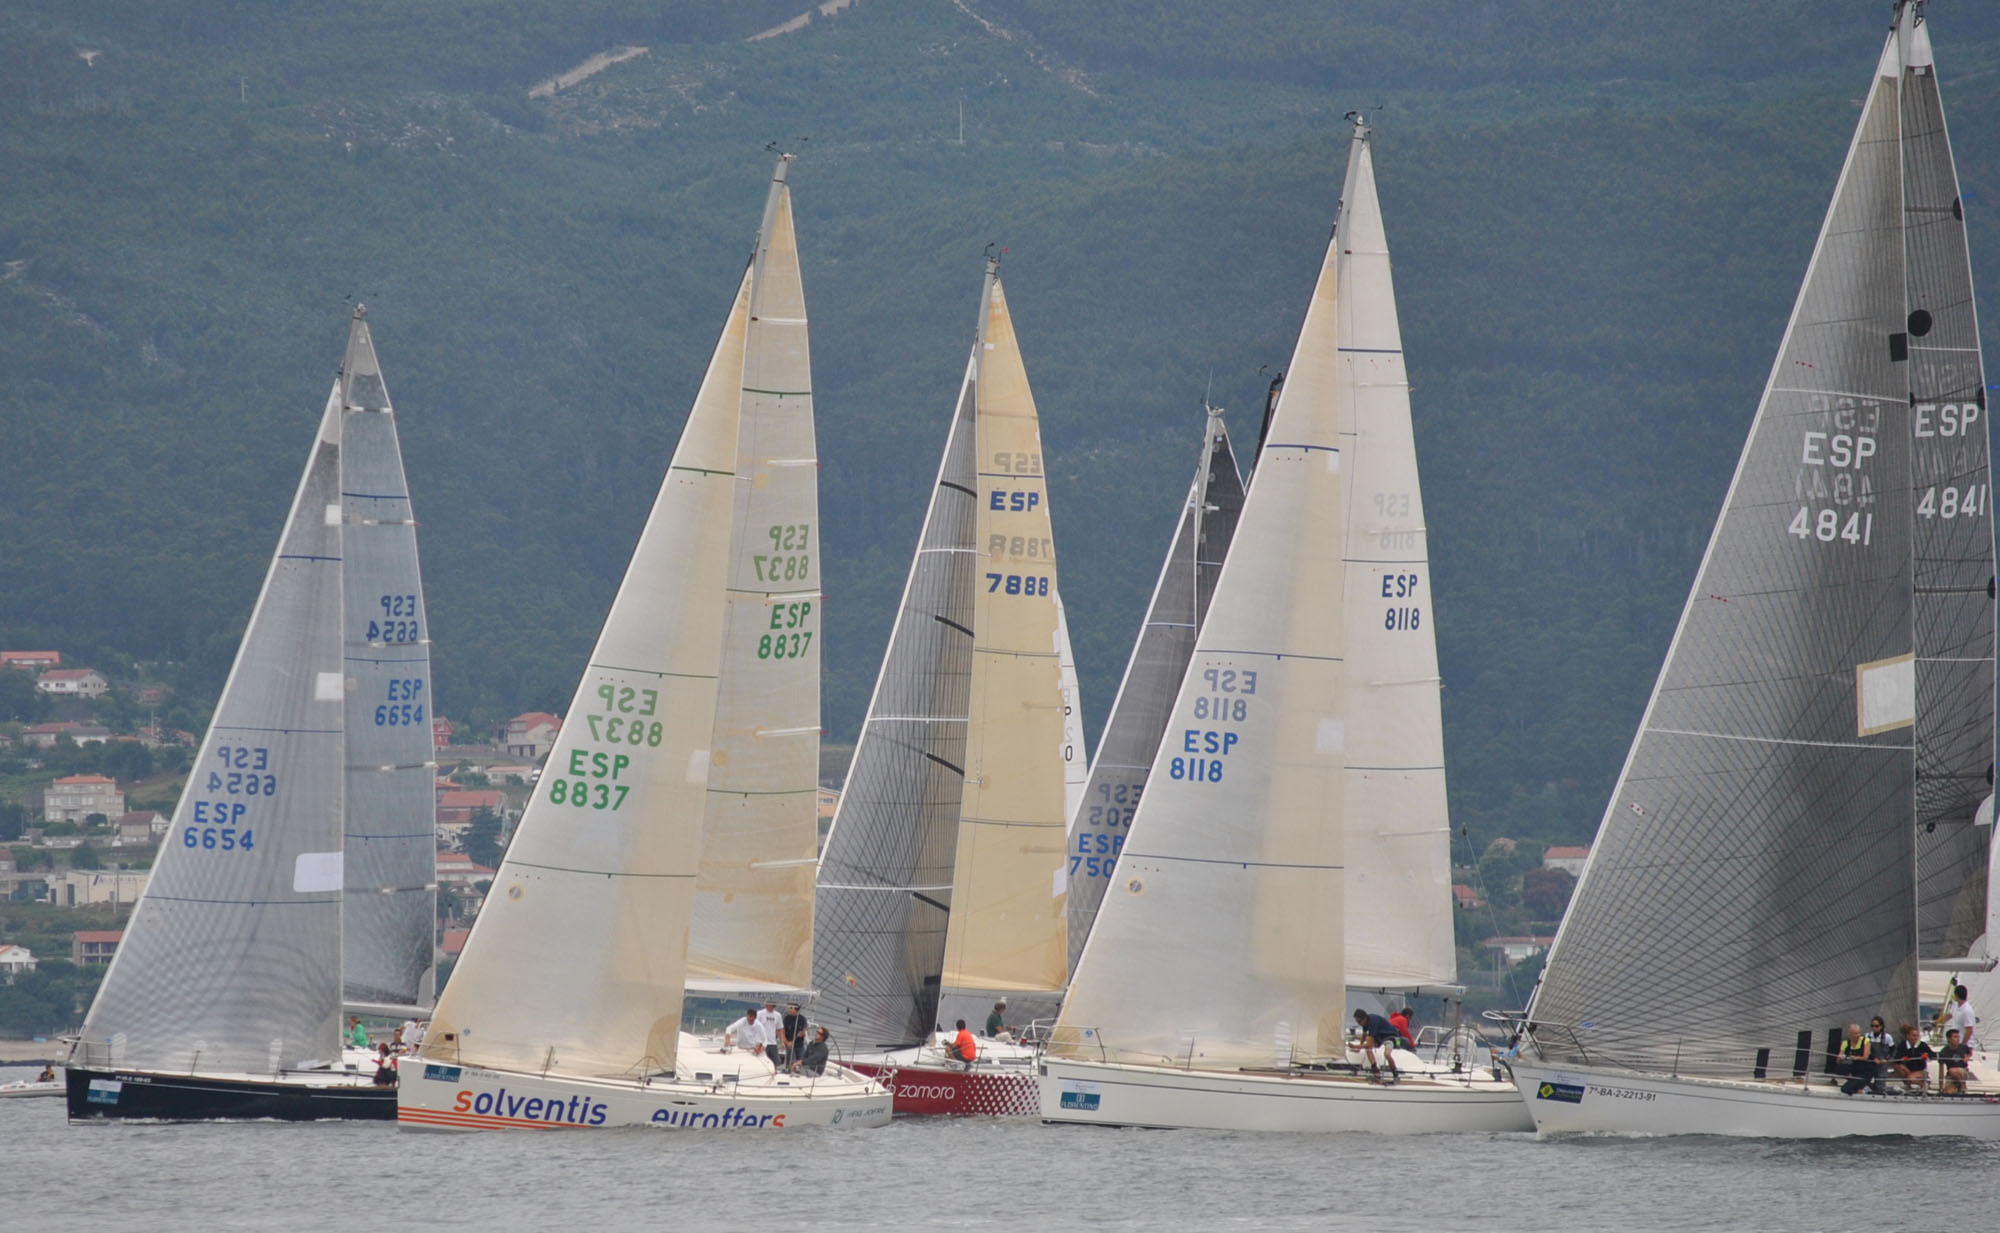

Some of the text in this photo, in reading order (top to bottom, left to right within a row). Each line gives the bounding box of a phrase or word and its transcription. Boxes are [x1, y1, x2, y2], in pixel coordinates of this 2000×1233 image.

[1915, 403, 1979, 438] ESP
[1802, 431, 1876, 470] ESP
[990, 490, 1040, 512] ESP
[1917, 484, 1986, 519] 4841
[1788, 506, 1873, 546] 4841
[986, 572, 1049, 597] 7888
[1382, 574, 1418, 598] ESP
[770, 602, 811, 630] ESP
[1385, 607, 1420, 631] 8118
[758, 632, 812, 660] 8837
[388, 679, 423, 701] ESP
[374, 704, 423, 727] 6654
[1184, 729, 1239, 755] ESP
[568, 749, 630, 780] ESP
[1169, 757, 1223, 783] 8118
[549, 778, 630, 811] 8837
[193, 801, 246, 825] ESP
[183, 827, 254, 851] 6654
[1079, 833, 1124, 855] ESP
[1070, 856, 1115, 879] 750
[898, 1084, 955, 1100] zamora
[453, 1088, 608, 1126] solventis
[651, 1107, 786, 1129] euroffers
